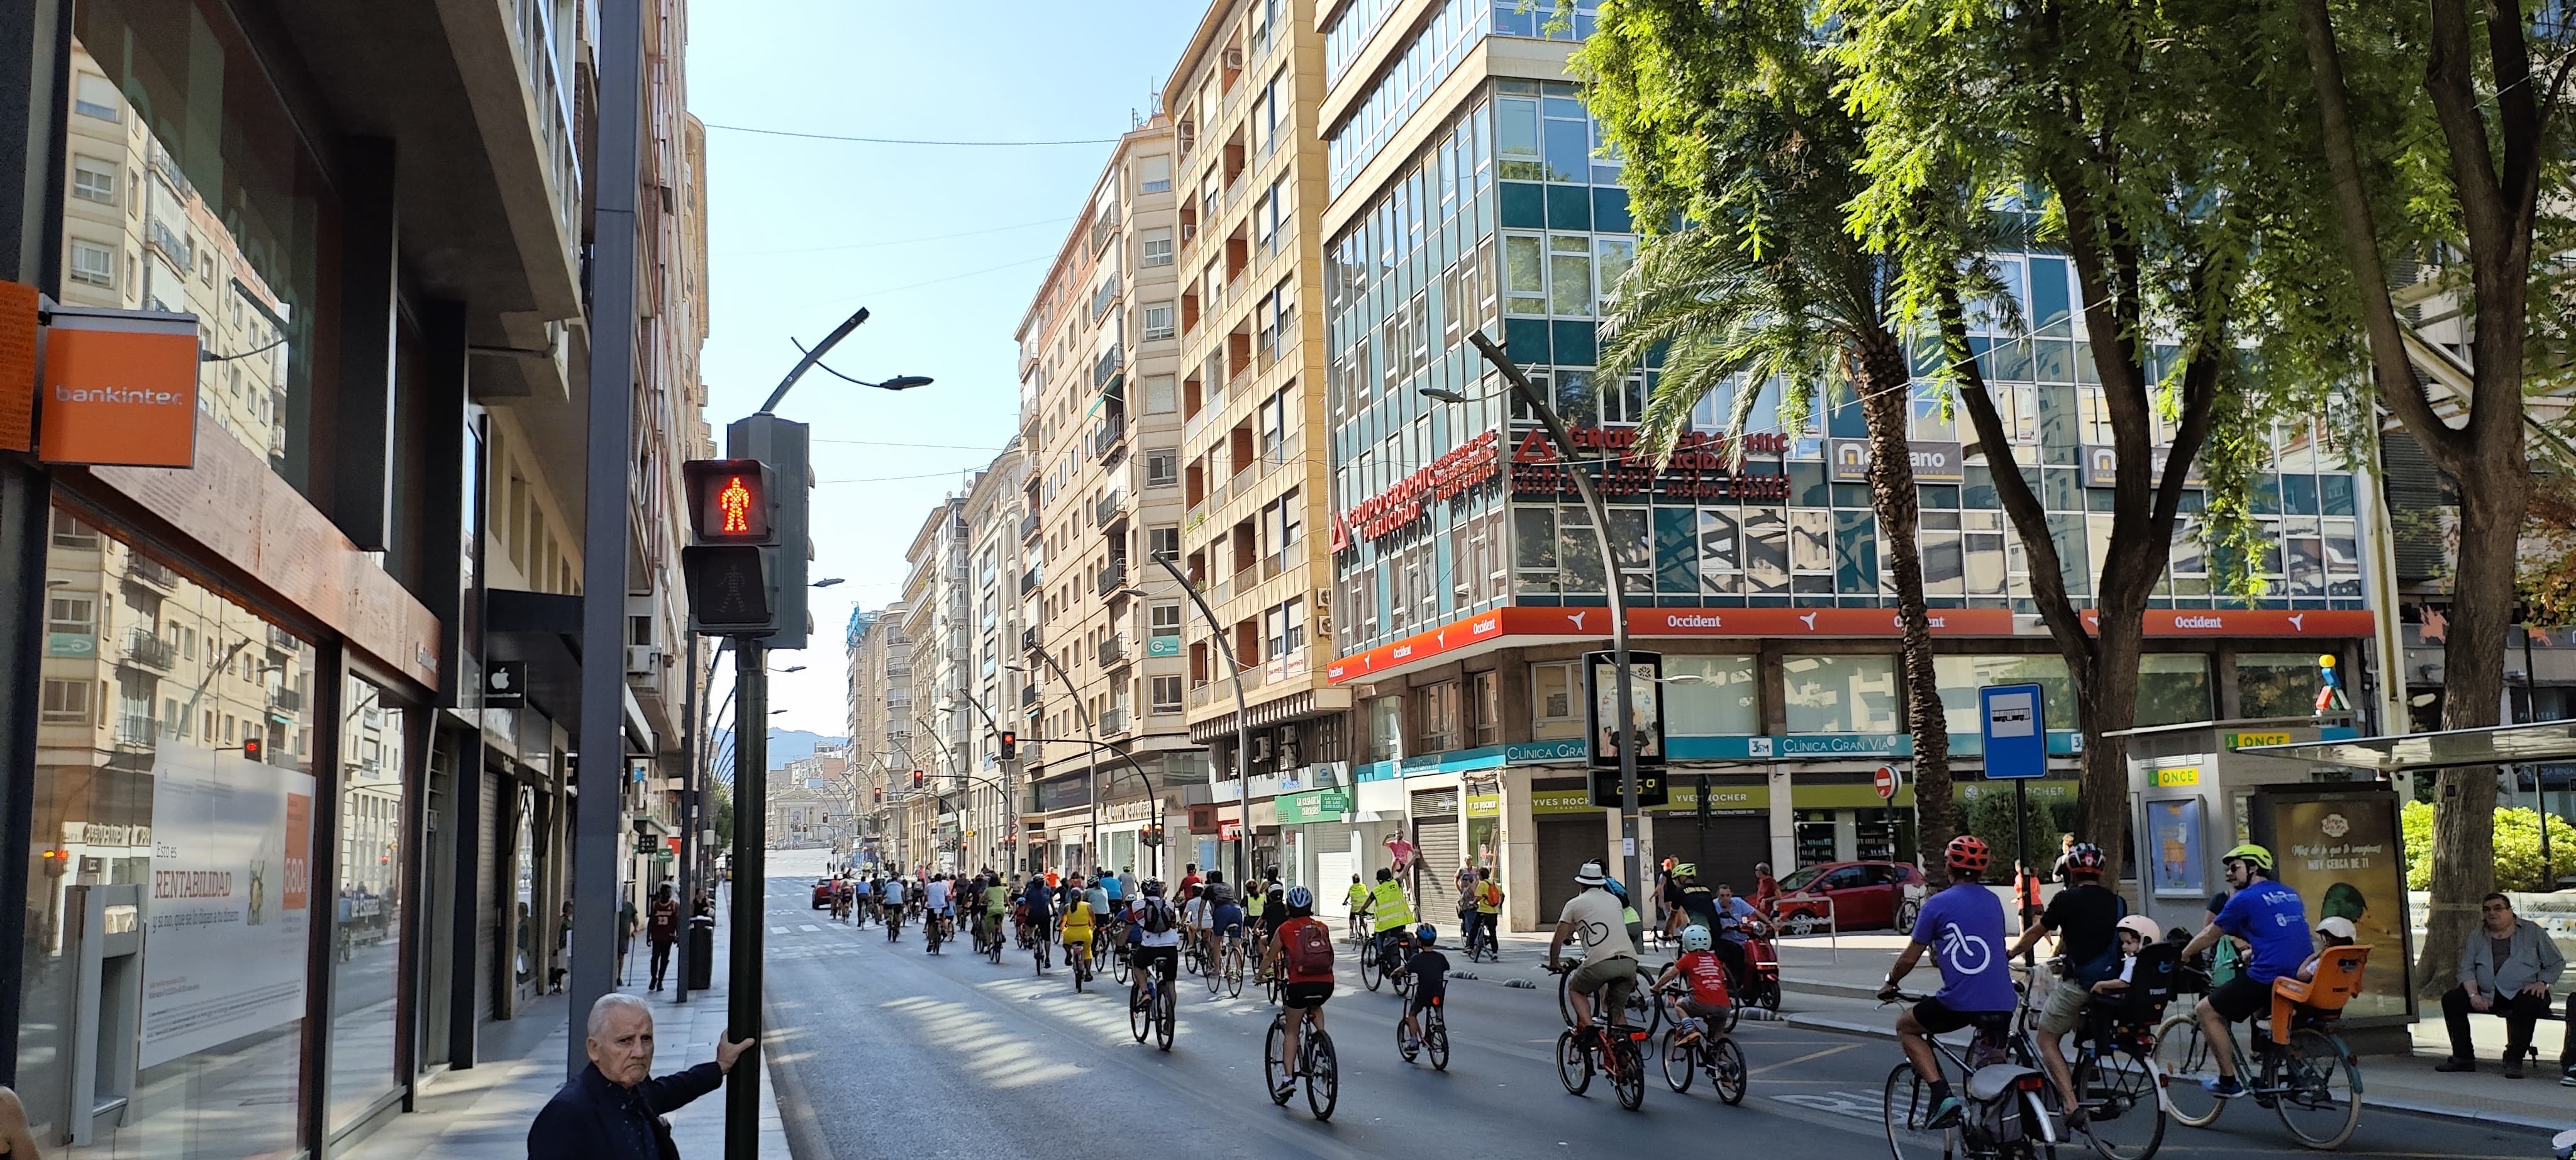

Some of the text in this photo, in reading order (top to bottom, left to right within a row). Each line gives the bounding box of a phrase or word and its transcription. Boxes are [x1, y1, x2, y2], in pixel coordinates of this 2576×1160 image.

[1568, 426, 1638, 449] GRUP
[1601, 469, 1657, 483] RADIO
[1348, 467, 1437, 529] GRUPO GRAPHIC
[1363, 501, 1420, 543] PUBLICIDAD
[1473, 617, 1496, 635] Occident
[1667, 615, 1721, 627] Occident
[2175, 616, 2223, 628] Occident
[1393, 644, 1412, 660] Occident
[1328, 665, 1343, 678] Occident
[1783, 738, 1889, 752] CLÍNICA GRAN VÍA
[2244, 736, 2284, 747] ONCE
[1507, 744, 1586, 760] CLÍNICA GRA
[2163, 770, 2194, 784] ONCE
[2025, 786, 2065, 796] OCHER
[1533, 797, 1558, 806] YVES
[157, 841, 177, 858] Esto es
[2307, 857, 2369, 870] MUY CERCA DE TI
[155, 871, 232, 899] RENTABILIDAD
